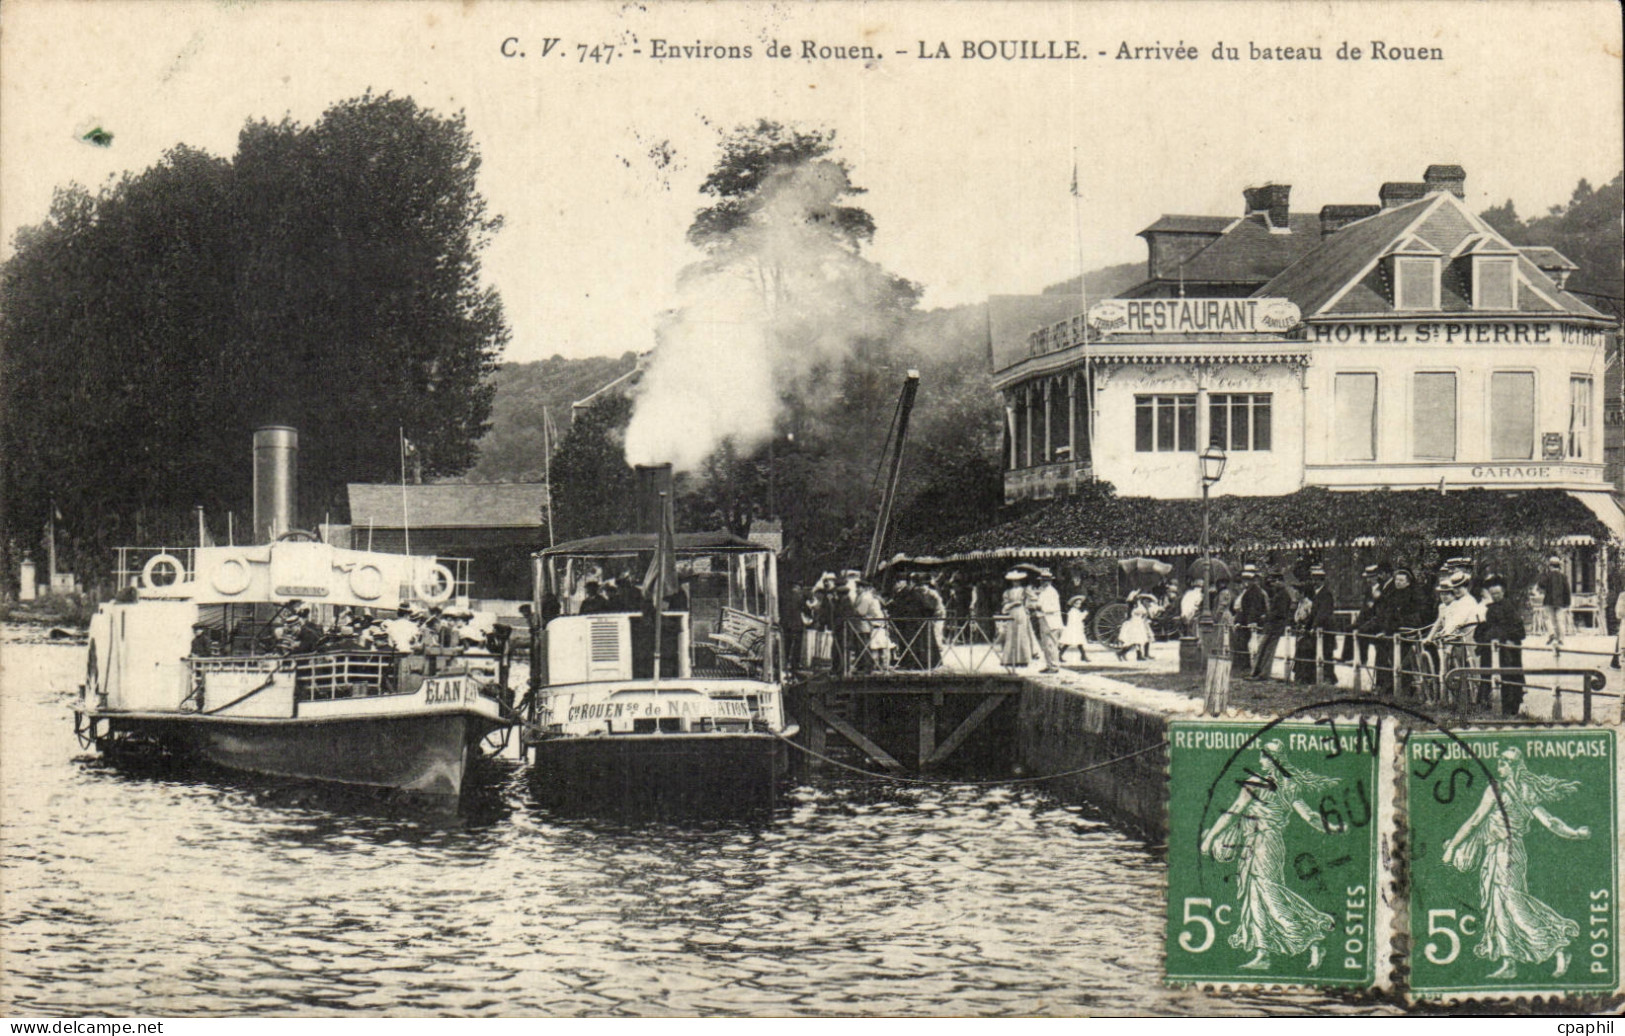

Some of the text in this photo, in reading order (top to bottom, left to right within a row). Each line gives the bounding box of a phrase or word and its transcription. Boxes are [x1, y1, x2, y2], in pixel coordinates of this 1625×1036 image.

[500, 38, 525, 57] C.
[543, 38, 566, 57] V.
[650, 40, 753, 59] Environs
[766, 40, 792, 59] de
[802, 41, 883, 59] Rouen.
[918, 41, 951, 59] LA
[962, 41, 1087, 60] BOUILLE.
[1115, 40, 1198, 60] Arrivée
[1211, 41, 1239, 60] du
[1249, 41, 1322, 60] bateau
[1336, 41, 1362, 60] de
[1371, 41, 1443, 60] Rouen
[1127, 300, 1258, 330] RESTAURANT
[1314, 323, 1407, 343] HOTEL
[1449, 323, 1551, 343] PIERRE
[1471, 466, 1550, 478] GARAGE
[645, 702, 661, 716] de
[1525, 740, 1607, 759] FRANÇAISE
[1344, 884, 1366, 969] POSTES
[1590, 888, 1609, 973] POSTES
